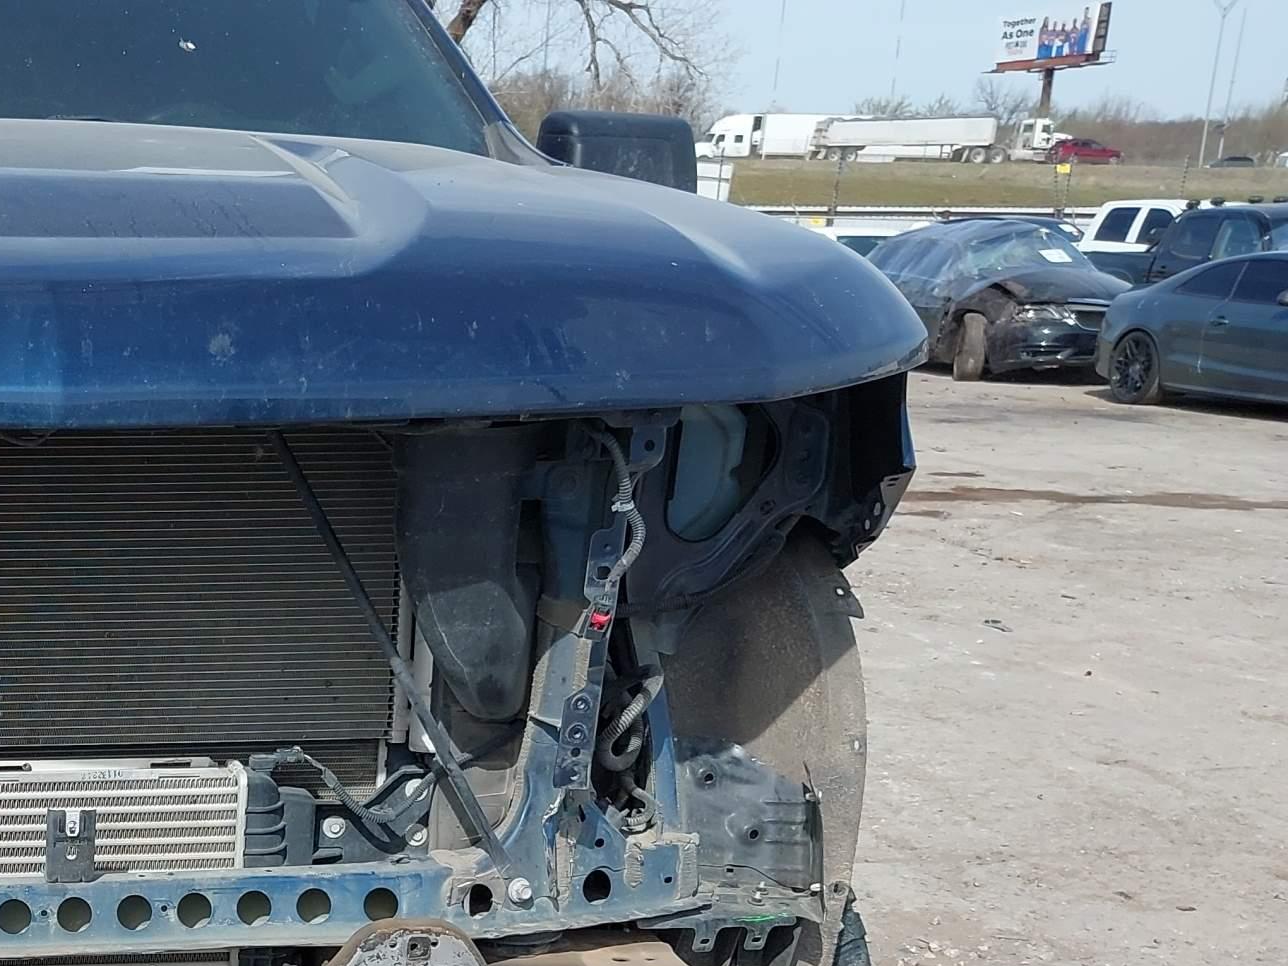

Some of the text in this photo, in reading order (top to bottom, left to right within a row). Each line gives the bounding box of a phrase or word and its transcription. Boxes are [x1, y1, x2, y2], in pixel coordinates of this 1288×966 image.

[1002, 17, 1037, 28] Together
[1001, 29, 1034, 40] As One
